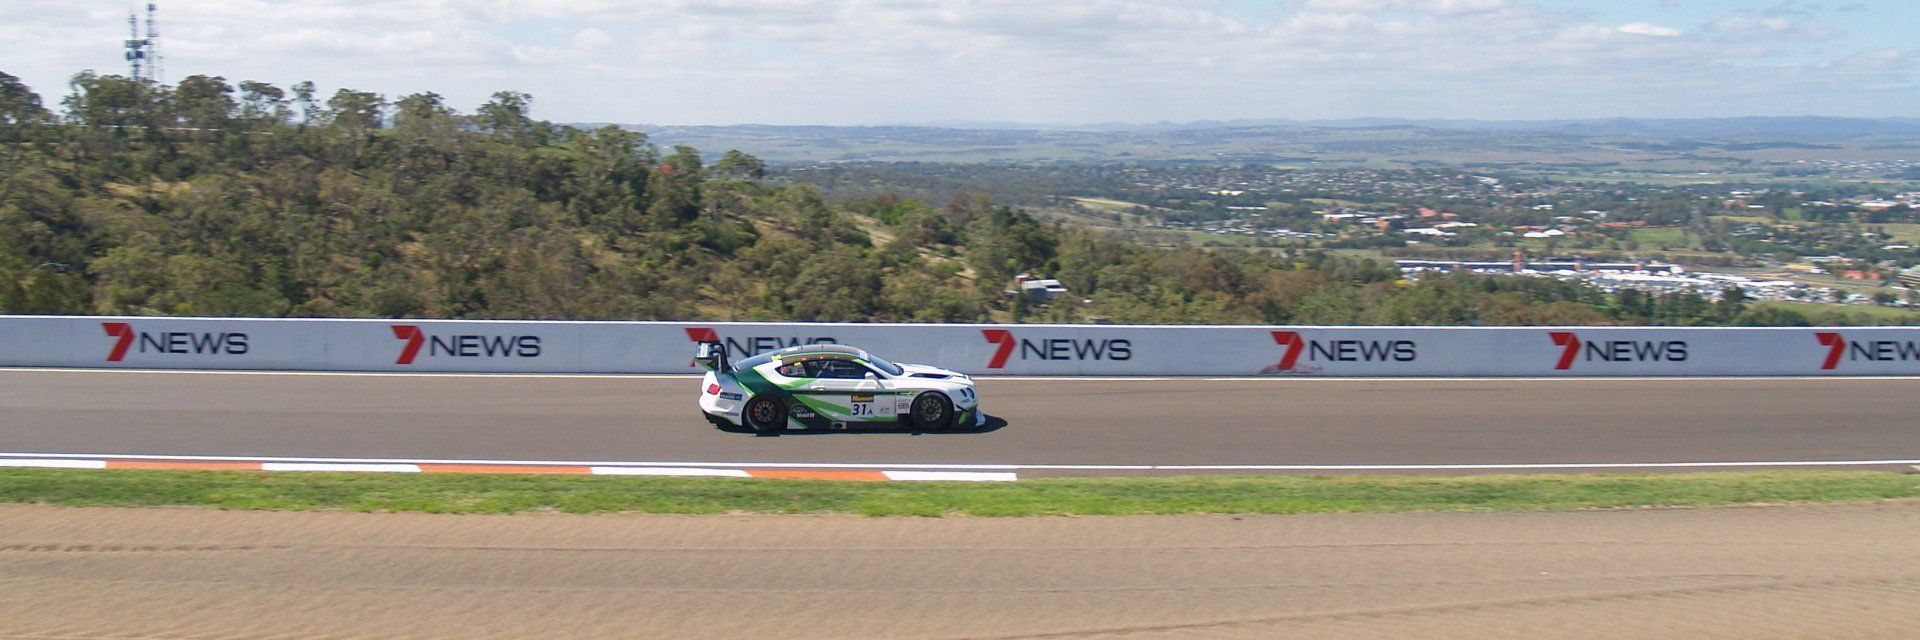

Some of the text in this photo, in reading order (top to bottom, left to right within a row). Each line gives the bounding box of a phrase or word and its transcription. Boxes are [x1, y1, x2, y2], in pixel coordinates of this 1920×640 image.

[101, 322, 248, 361] 7 NEWS
[391, 325, 541, 364] 7 NEWS
[982, 329, 1132, 369] 7 NEWS
[1271, 331, 1417, 369] 7 NEWS
[1549, 332, 1688, 369] 7 NEWS
[1815, 332, 1847, 369] 7
